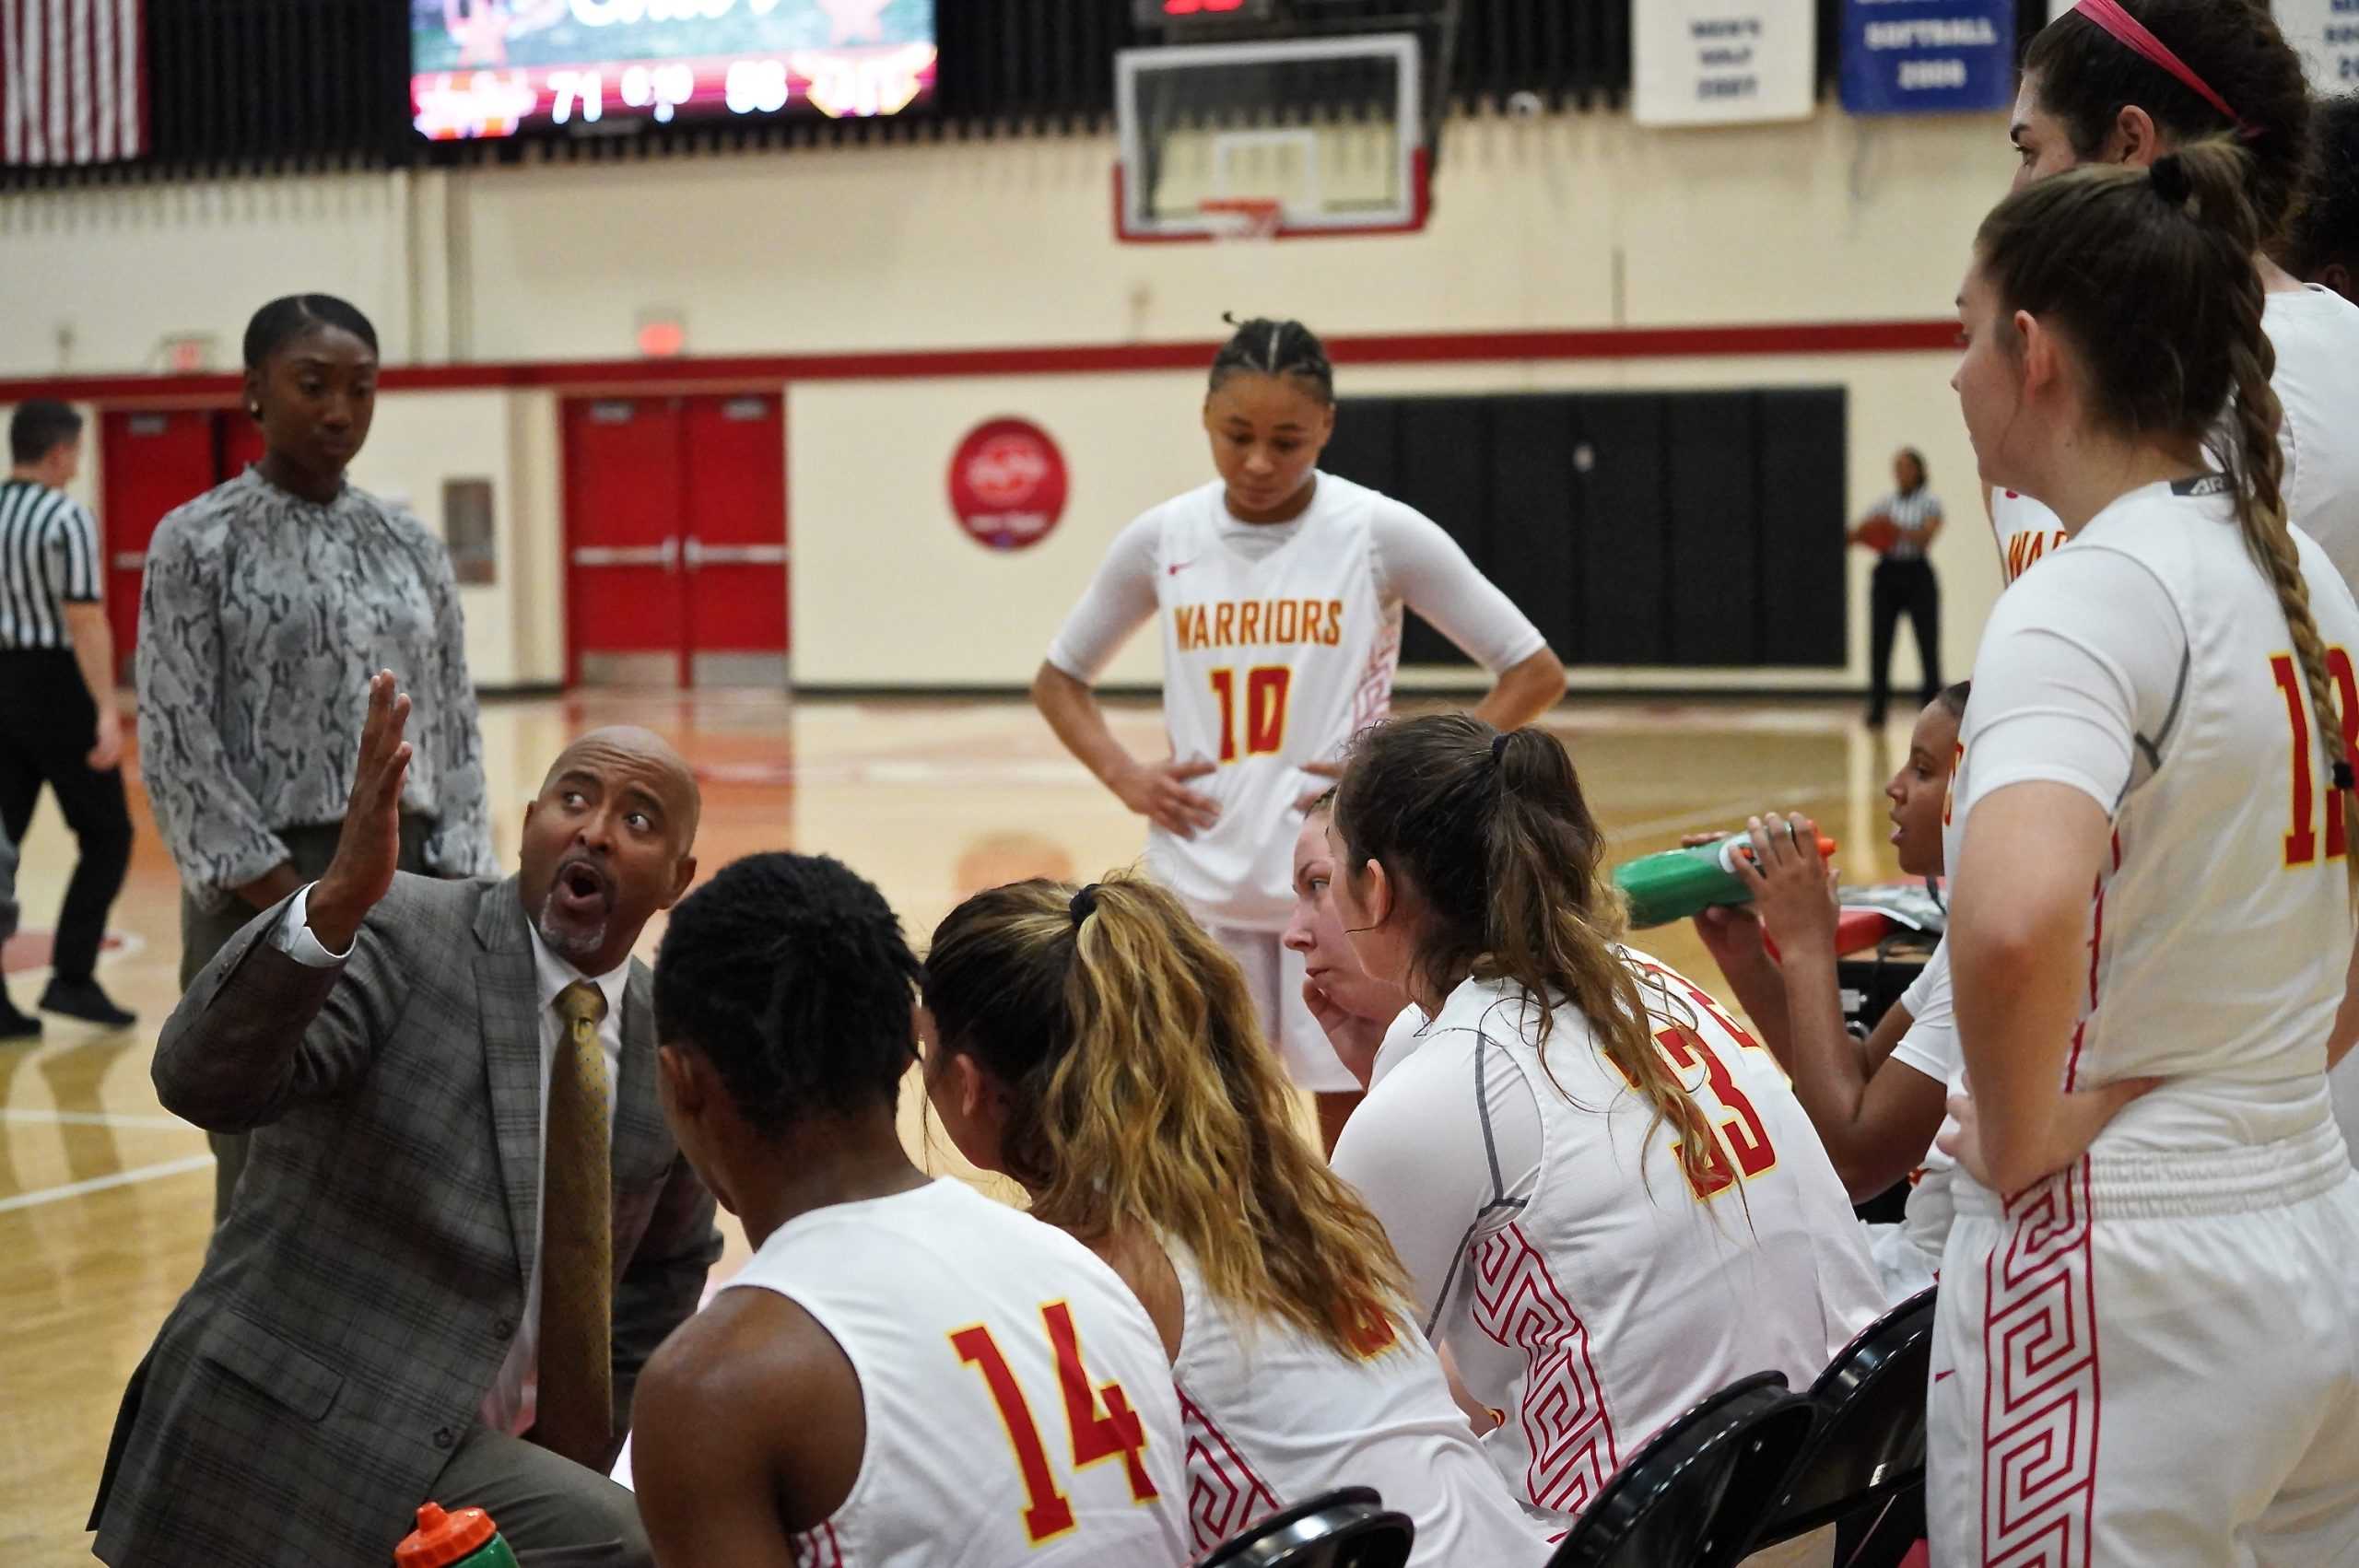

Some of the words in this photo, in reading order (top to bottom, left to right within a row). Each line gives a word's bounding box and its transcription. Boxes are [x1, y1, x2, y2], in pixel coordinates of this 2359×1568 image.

[547, 70, 603, 123] 71
[1172, 599, 1344, 652] WARRIORS
[1207, 661, 1292, 766] 10
[945, 1297, 1163, 1550] 14
